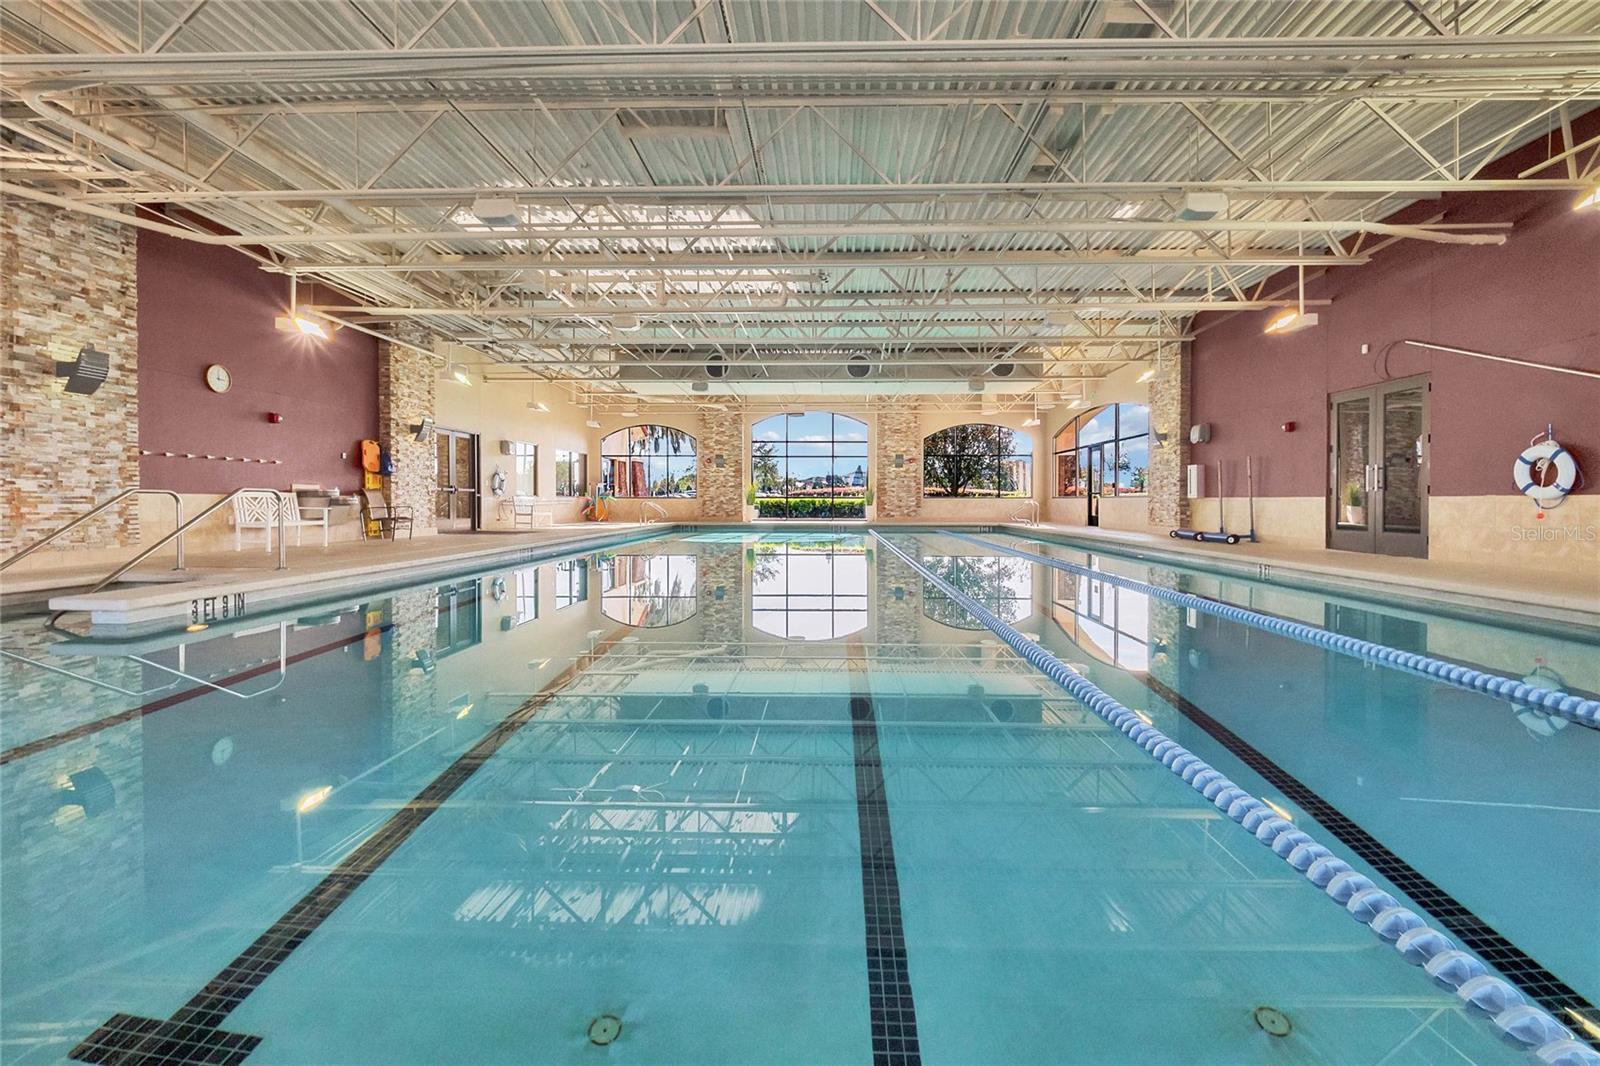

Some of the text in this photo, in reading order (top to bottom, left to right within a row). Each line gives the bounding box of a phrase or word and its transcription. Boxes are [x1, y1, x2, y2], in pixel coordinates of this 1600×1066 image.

[191, 600, 198, 614] 3
[204, 597, 217, 612] FT
[234, 593, 245, 608] IN
